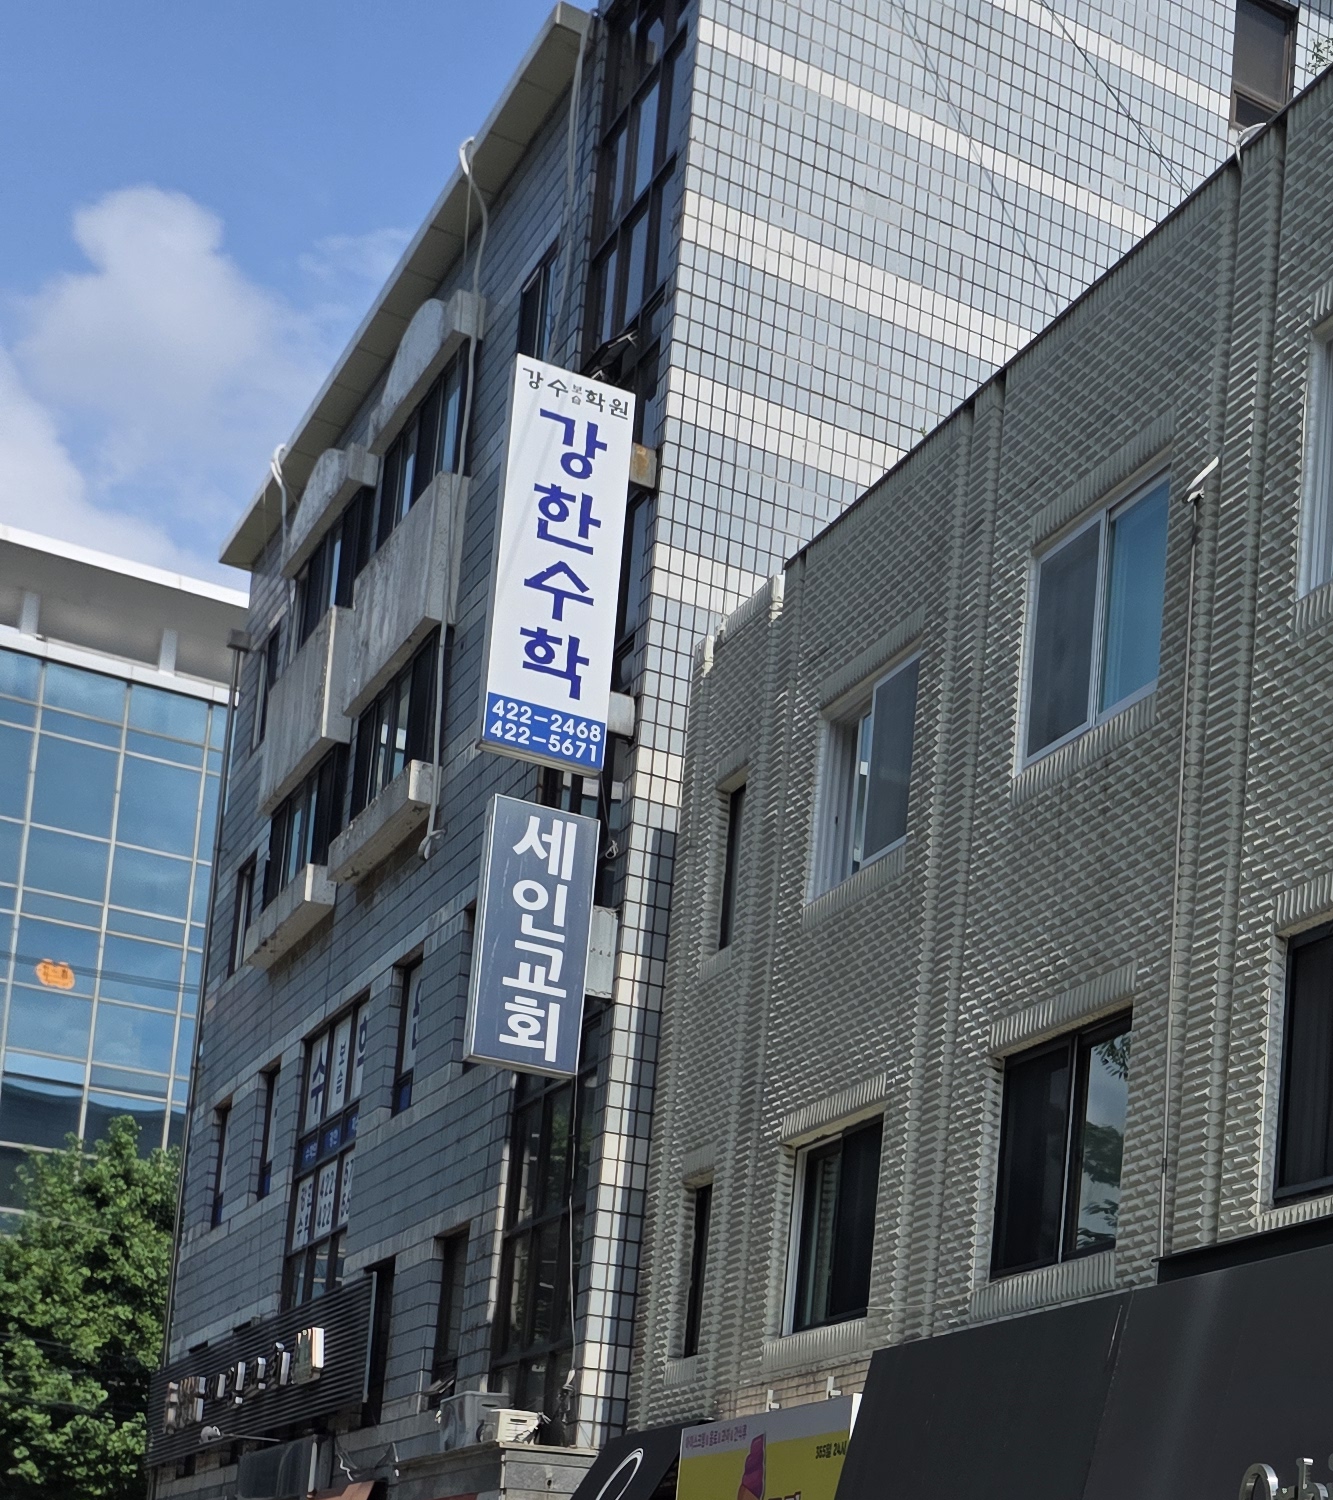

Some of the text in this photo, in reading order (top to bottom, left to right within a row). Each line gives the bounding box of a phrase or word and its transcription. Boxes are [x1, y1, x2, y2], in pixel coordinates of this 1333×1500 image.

[522, 408, 608, 700] 강한수학
[490, 721, 598, 763] 422-5671
[492, 699, 601, 742] 422-2468
[499, 815, 578, 1063] 세인교회
